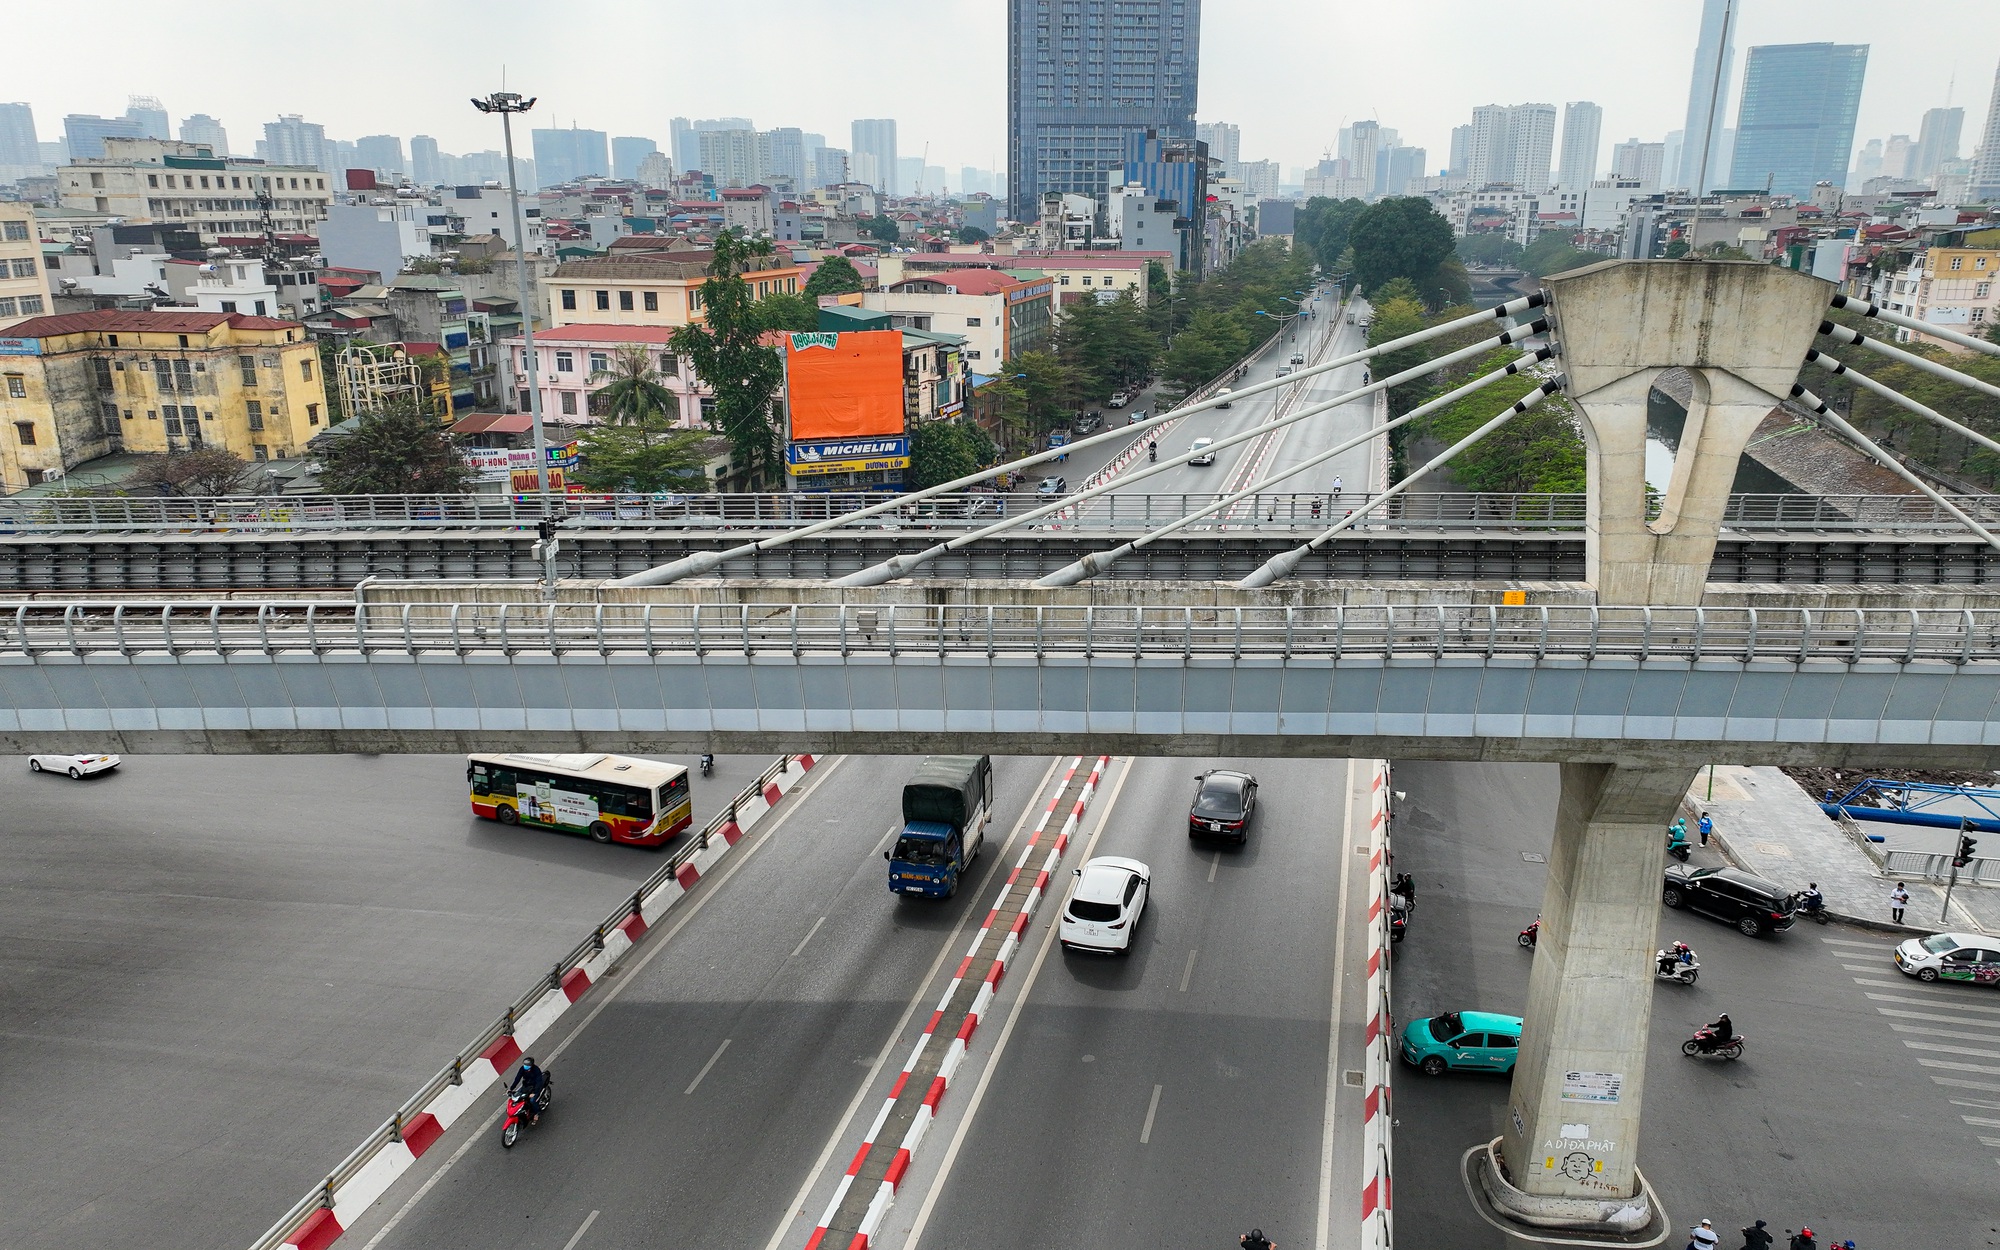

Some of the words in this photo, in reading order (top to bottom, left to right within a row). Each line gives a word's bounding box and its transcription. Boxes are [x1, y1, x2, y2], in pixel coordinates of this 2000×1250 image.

[547, 449, 566, 460] LED
[823, 442, 896, 456] MICHELIN
[891, 458, 904, 468] LỐP
